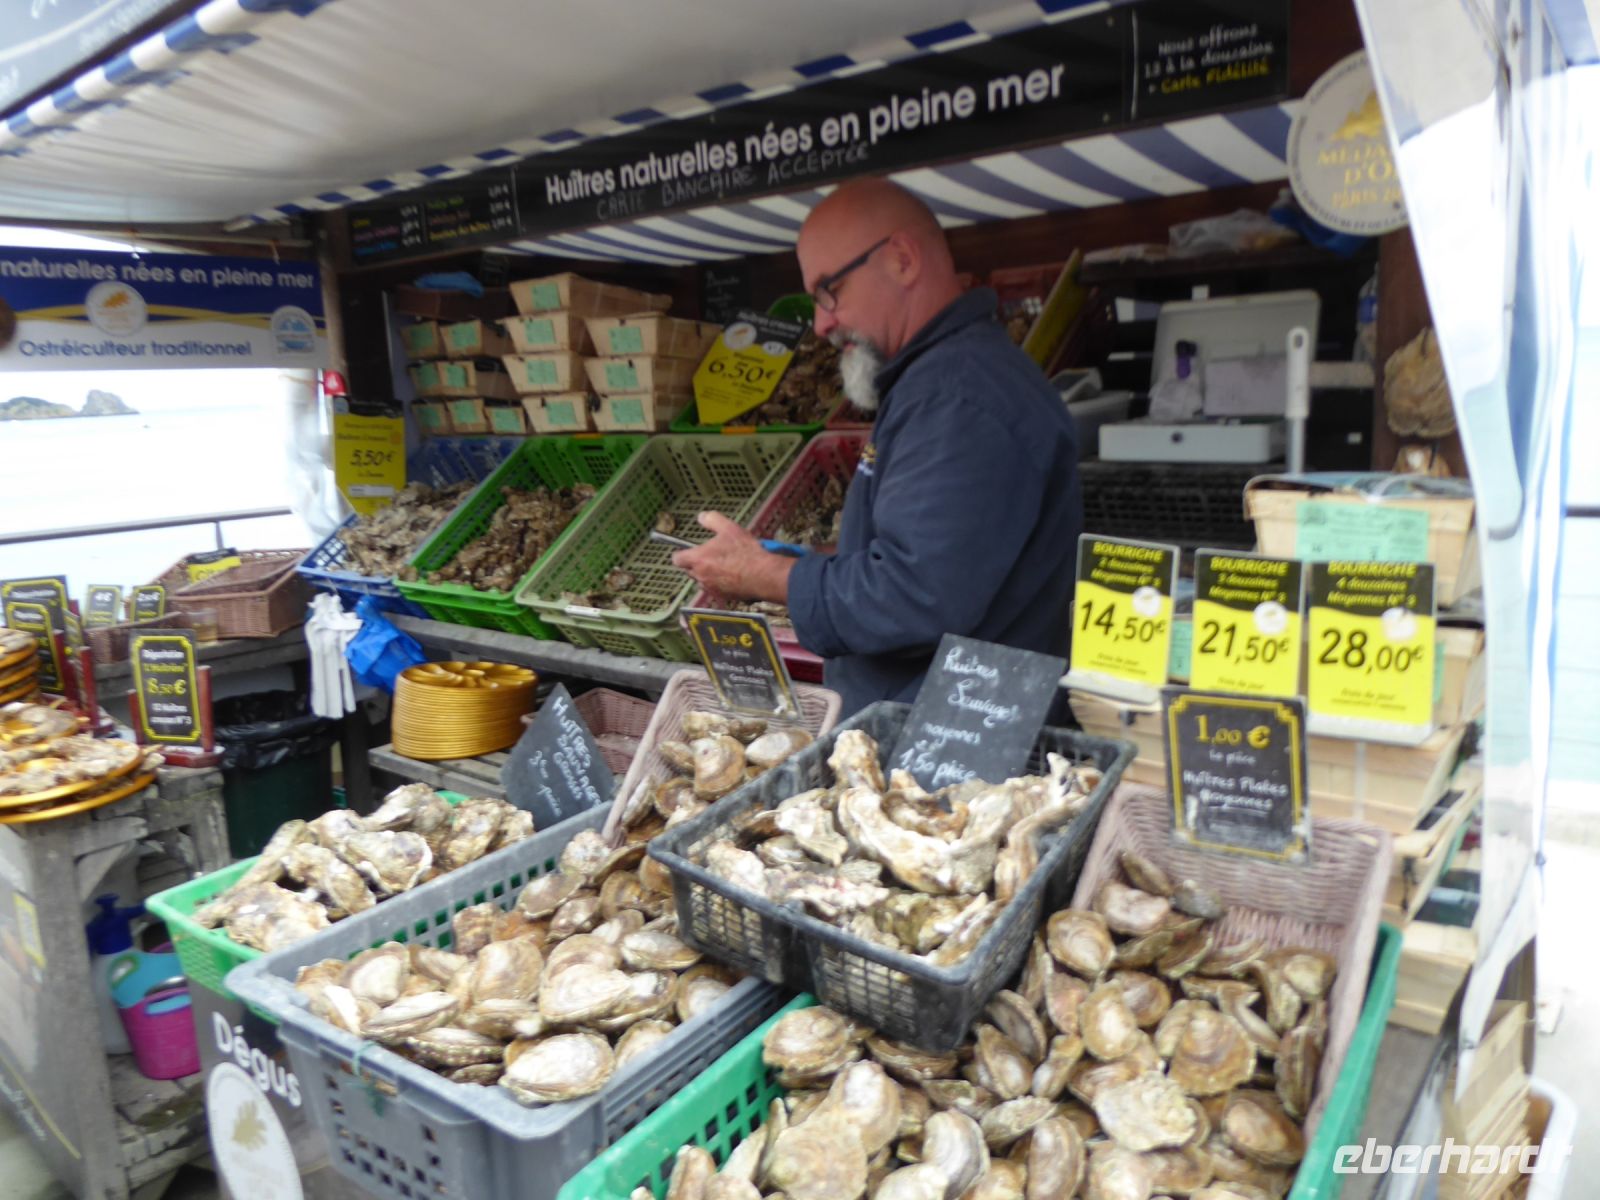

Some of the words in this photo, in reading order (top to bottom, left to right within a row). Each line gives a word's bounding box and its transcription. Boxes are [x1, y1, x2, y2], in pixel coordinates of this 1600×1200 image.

[545, 167, 615, 205] Huîtres
[620, 140, 738, 189] naturelles
[745, 120, 812, 162] nées
[820, 112, 860, 146] en
[870, 86, 976, 145] pleine
[988, 63, 1065, 111] mer
[661, 166, 757, 206] BANCAIRE
[1, 257, 117, 280] naturelles
[122, 260, 174, 283] nées
[180, 265, 208, 285] en
[213, 266, 273, 288] pleine
[277, 272, 315, 289] mer
[18, 338, 147, 358] Ostréiculteur
[151, 339, 252, 357] traditionnel
[1093, 541, 1164, 563] BOURRICHE
[1108, 558, 1154, 574] douzaines
[1210, 556, 1290, 575] BOURRICHE
[1327, 561, 1418, 578] BOURRICHE
[1090, 569, 1137, 585] Moyennes
[1226, 573, 1279, 589] douzaines
[1337, 577, 1346, 589] 4
[1346, 577, 1408, 592] douzaines
[1208, 586, 1259, 602] Moyennes
[1327, 591, 1386, 607] Moyennes
[1081, 599, 1166, 643] 14,50€
[1198, 620, 1291, 664] 21,50€
[1318, 628, 1425, 675] 28,00€
[1247, 725, 1272, 749] €
[1239, 776, 1289, 798] Plates
[212, 1011, 302, 1107] Dégus
